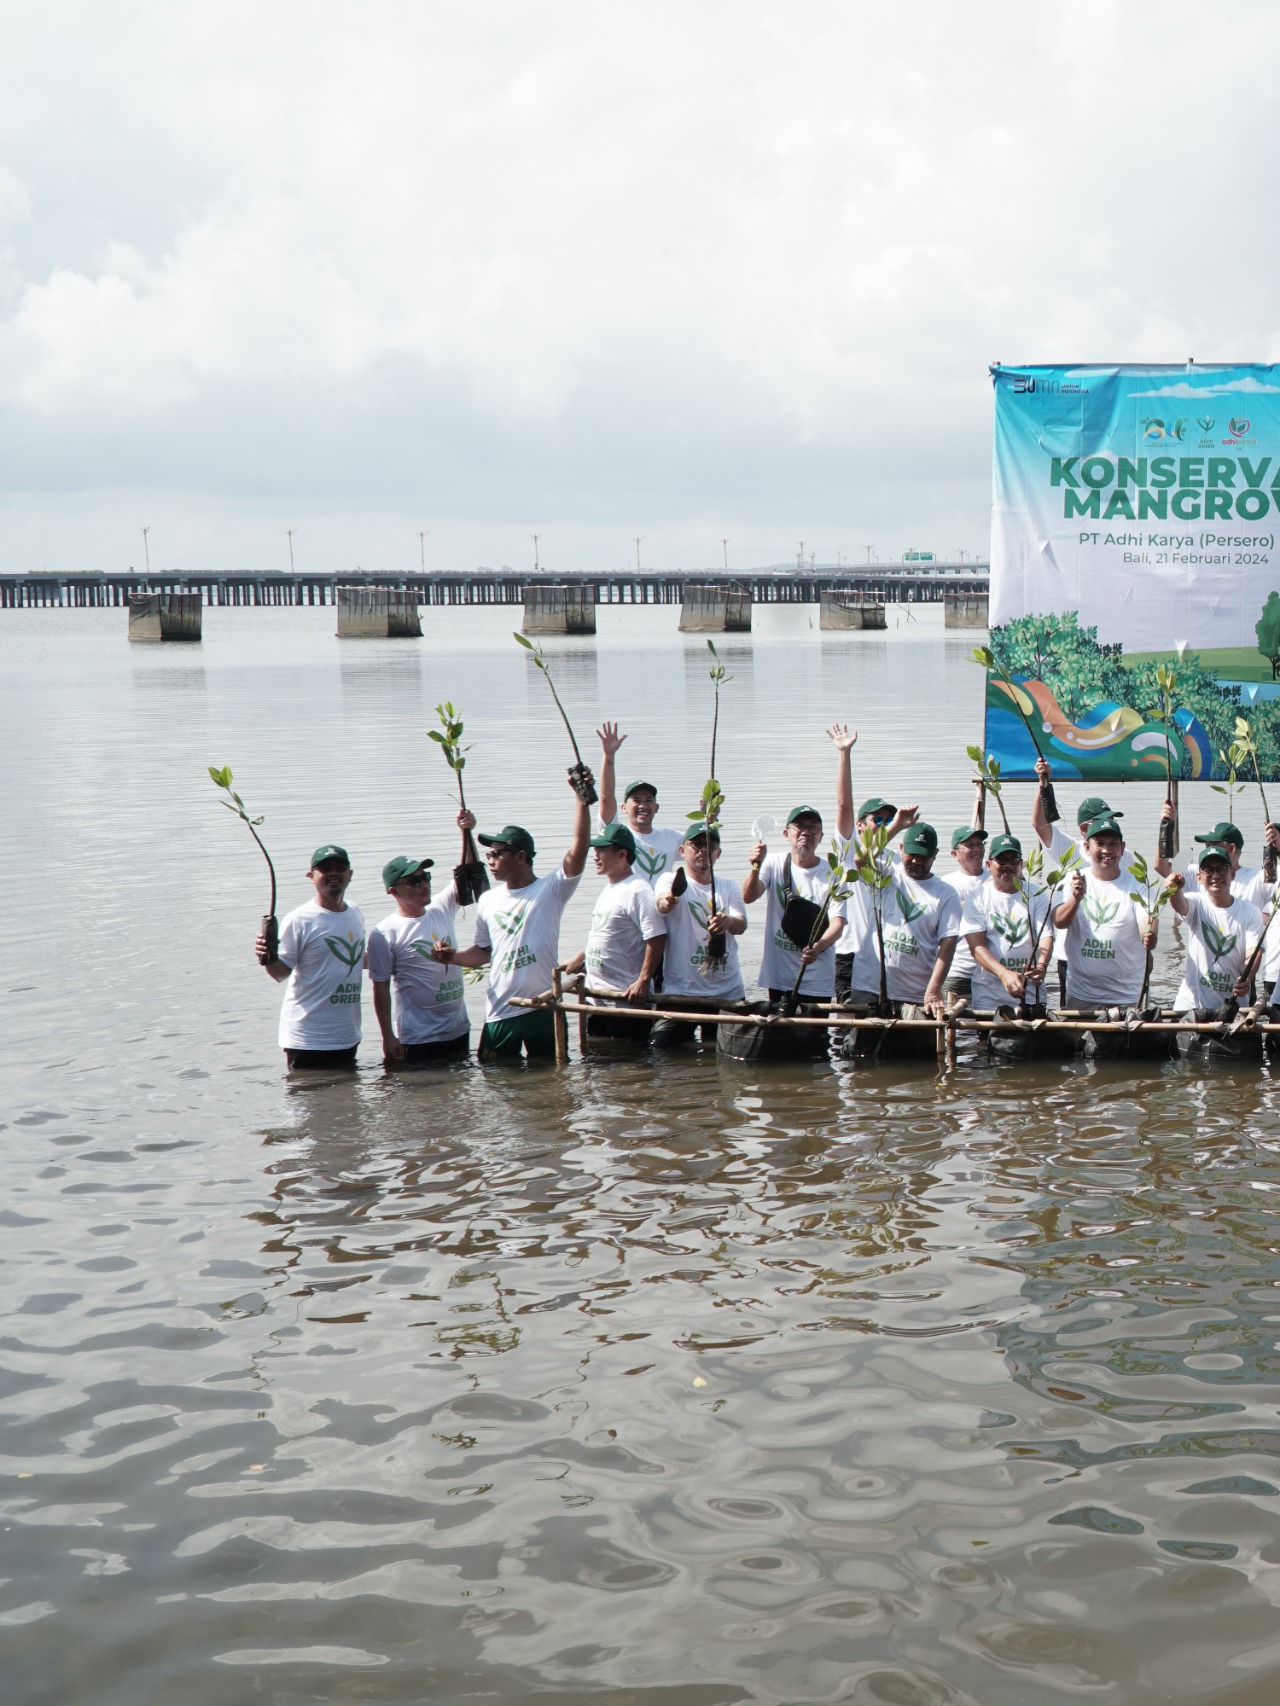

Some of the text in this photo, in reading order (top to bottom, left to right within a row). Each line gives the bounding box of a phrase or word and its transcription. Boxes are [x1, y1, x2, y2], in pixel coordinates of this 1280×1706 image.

[1079, 533, 1100, 545] PT
[1104, 533, 1143, 547] Adhi
[1148, 534, 1194, 550] Karya
[1199, 534, 1275, 550] (Persero)
[1123, 552, 1269, 565] Bali, 21 Februari 2024
[889, 931, 918, 946] ADHI
[1084, 938, 1112, 949] ADHI
[883, 939, 920, 956] GREEN
[1081, 948, 1115, 960] GREEN
[1000, 957, 1028, 967] ADHI
[336, 983, 360, 993] ADH
